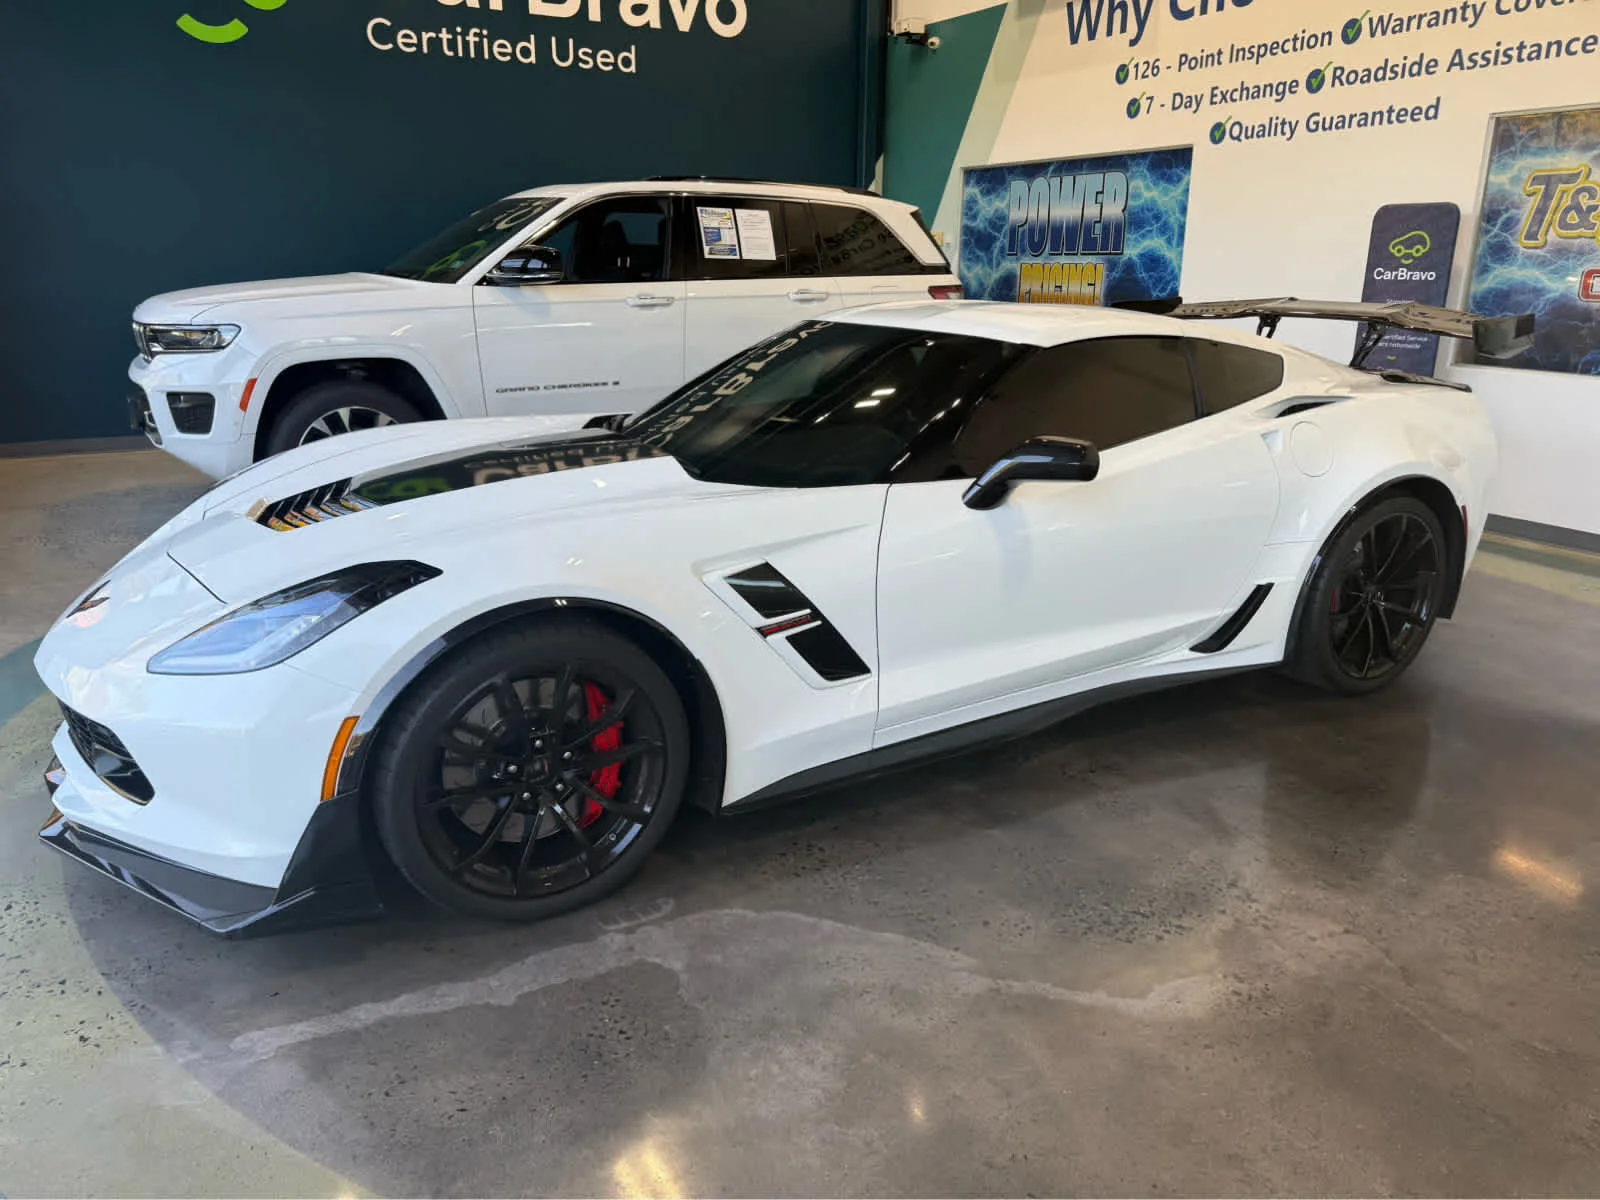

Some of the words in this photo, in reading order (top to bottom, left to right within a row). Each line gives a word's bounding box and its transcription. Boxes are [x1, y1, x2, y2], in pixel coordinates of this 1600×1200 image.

[366, 17, 536, 65] Certified
[551, 36, 636, 73] Used
[1066, 0, 1154, 48] Why
[1133, 59, 1160, 81] 126
[1178, 49, 1223, 73] Point
[1229, 29, 1333, 65] Inspection
[1368, 1, 1487, 38] Warranty
[1146, 96, 1155, 115] 7
[1171, 92, 1204, 114] Day
[1209, 79, 1300, 105] Exchange
[1330, 53, 1439, 88] Roadside
[1446, 34, 1599, 73] Assistance
[1229, 116, 1300, 143] Quality
[1306, 97, 1441, 133] Guaranteed
[1007, 171, 1129, 257] POWER
[1519, 163, 1600, 249] T&
[1017, 261, 1105, 305] PRICING!
[1373, 267, 1437, 281] CarBravo
